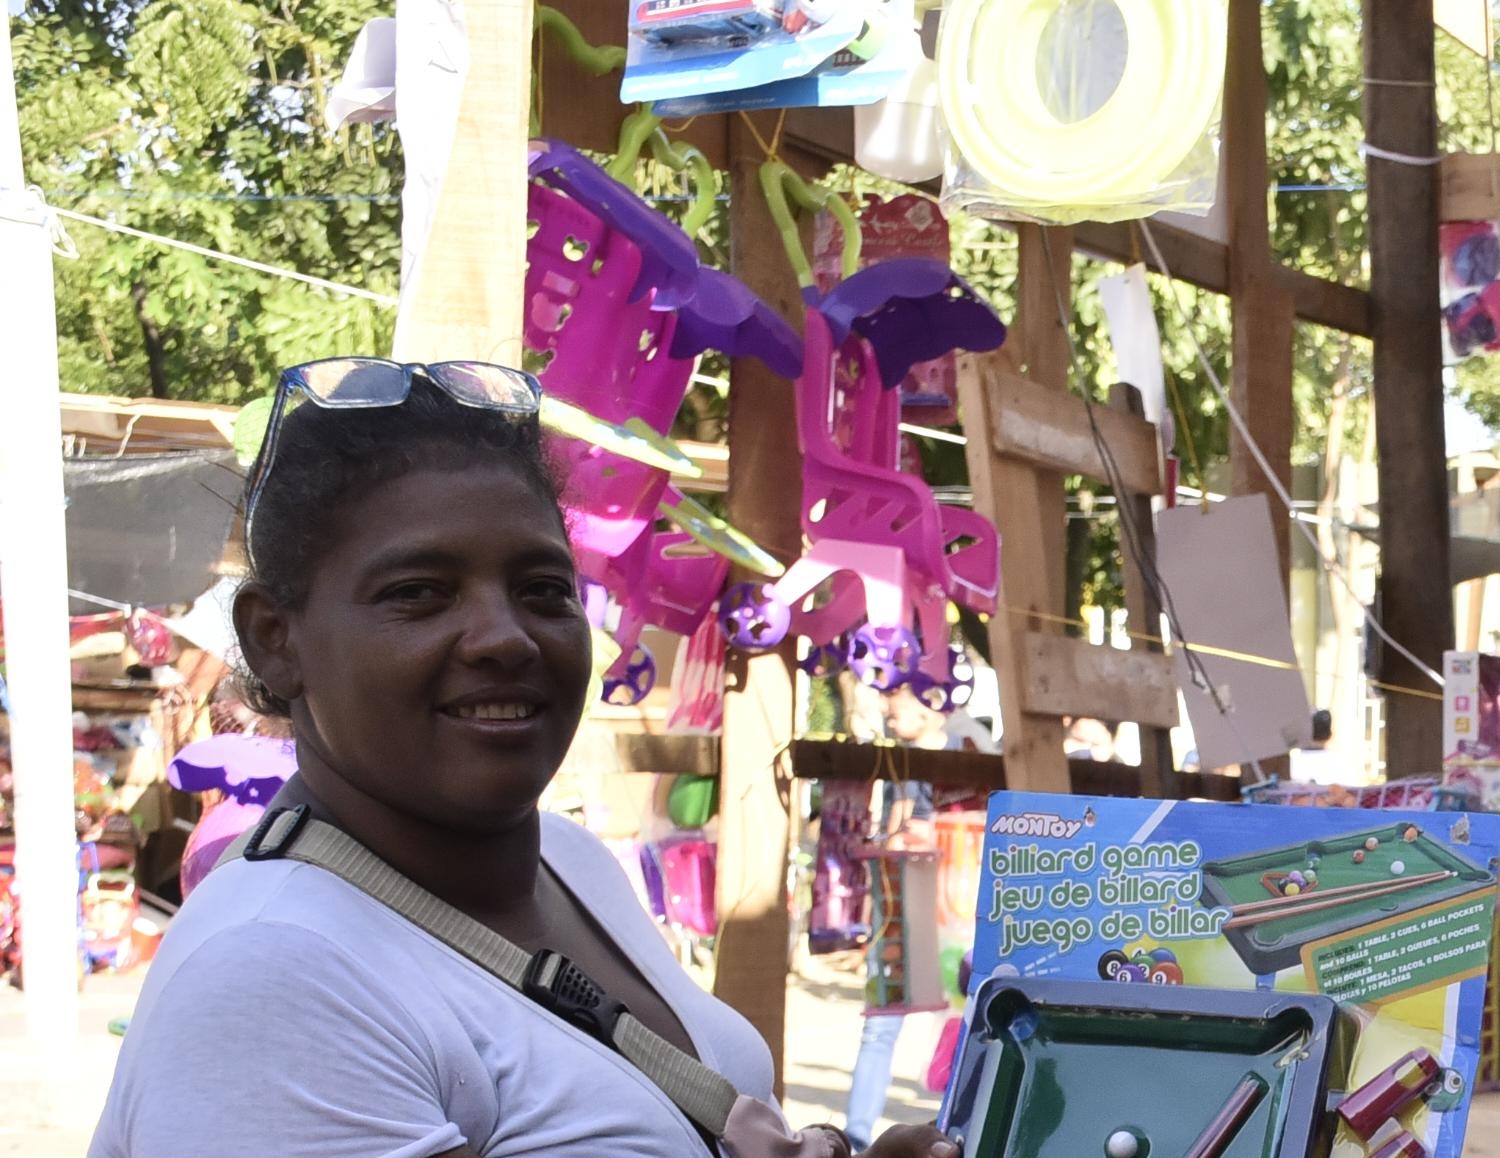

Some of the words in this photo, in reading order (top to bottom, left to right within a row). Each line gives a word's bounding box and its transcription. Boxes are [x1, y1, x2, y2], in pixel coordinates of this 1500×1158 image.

[992, 814, 1082, 838] MONTOY
[991, 844, 1095, 875] billiard
[1102, 843, 1199, 877] game
[990, 880, 1042, 921] jeu
[1051, 880, 1090, 907] de
[1099, 873, 1199, 905] billard
[1001, 916, 1092, 955] juego
[1100, 911, 1140, 939] de
[1150, 906, 1229, 935] billar
[1364, 934, 1390, 950] TABLE,
[1397, 926, 1420, 938] CUES,
[1427, 916, 1447, 928] BALL
[1447, 903, 1485, 922] POCKETS
[1346, 949, 1369, 963] BALLS
[1374, 949, 1400, 964] TABLE,
[1447, 923, 1481, 941] POCHES
[1109, 962, 1119, 974] 8
[1119, 971, 1128, 982] 6
[1343, 966, 1373, 983] BOULES
[1366, 971, 1391, 984] MESA,
[1397, 959, 1426, 974] TACOS,
[1433, 946, 1465, 963] BOLSOS
[1465, 940, 1488, 954] PARA
[1154, 973, 1164, 984] 9
[1331, 988, 1361, 1003] ELOTAS
[1368, 983, 1378, 993] 10
[1378, 972, 1413, 991] PELOTAS
